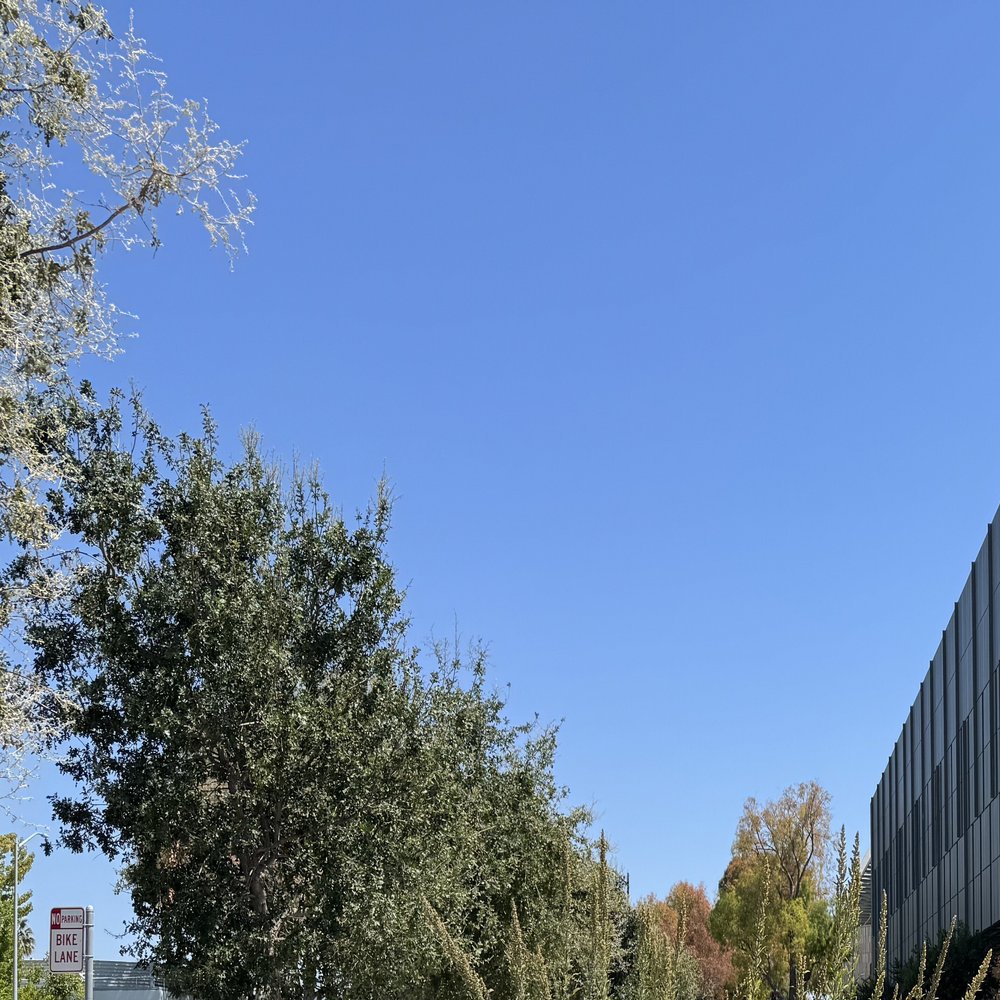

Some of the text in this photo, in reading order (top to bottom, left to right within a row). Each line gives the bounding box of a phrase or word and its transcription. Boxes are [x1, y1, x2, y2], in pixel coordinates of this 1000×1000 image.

[51, 912, 82, 925] NO PARKING
[56, 934, 78, 946] BIKE
[54, 951, 78, 962] LANE
